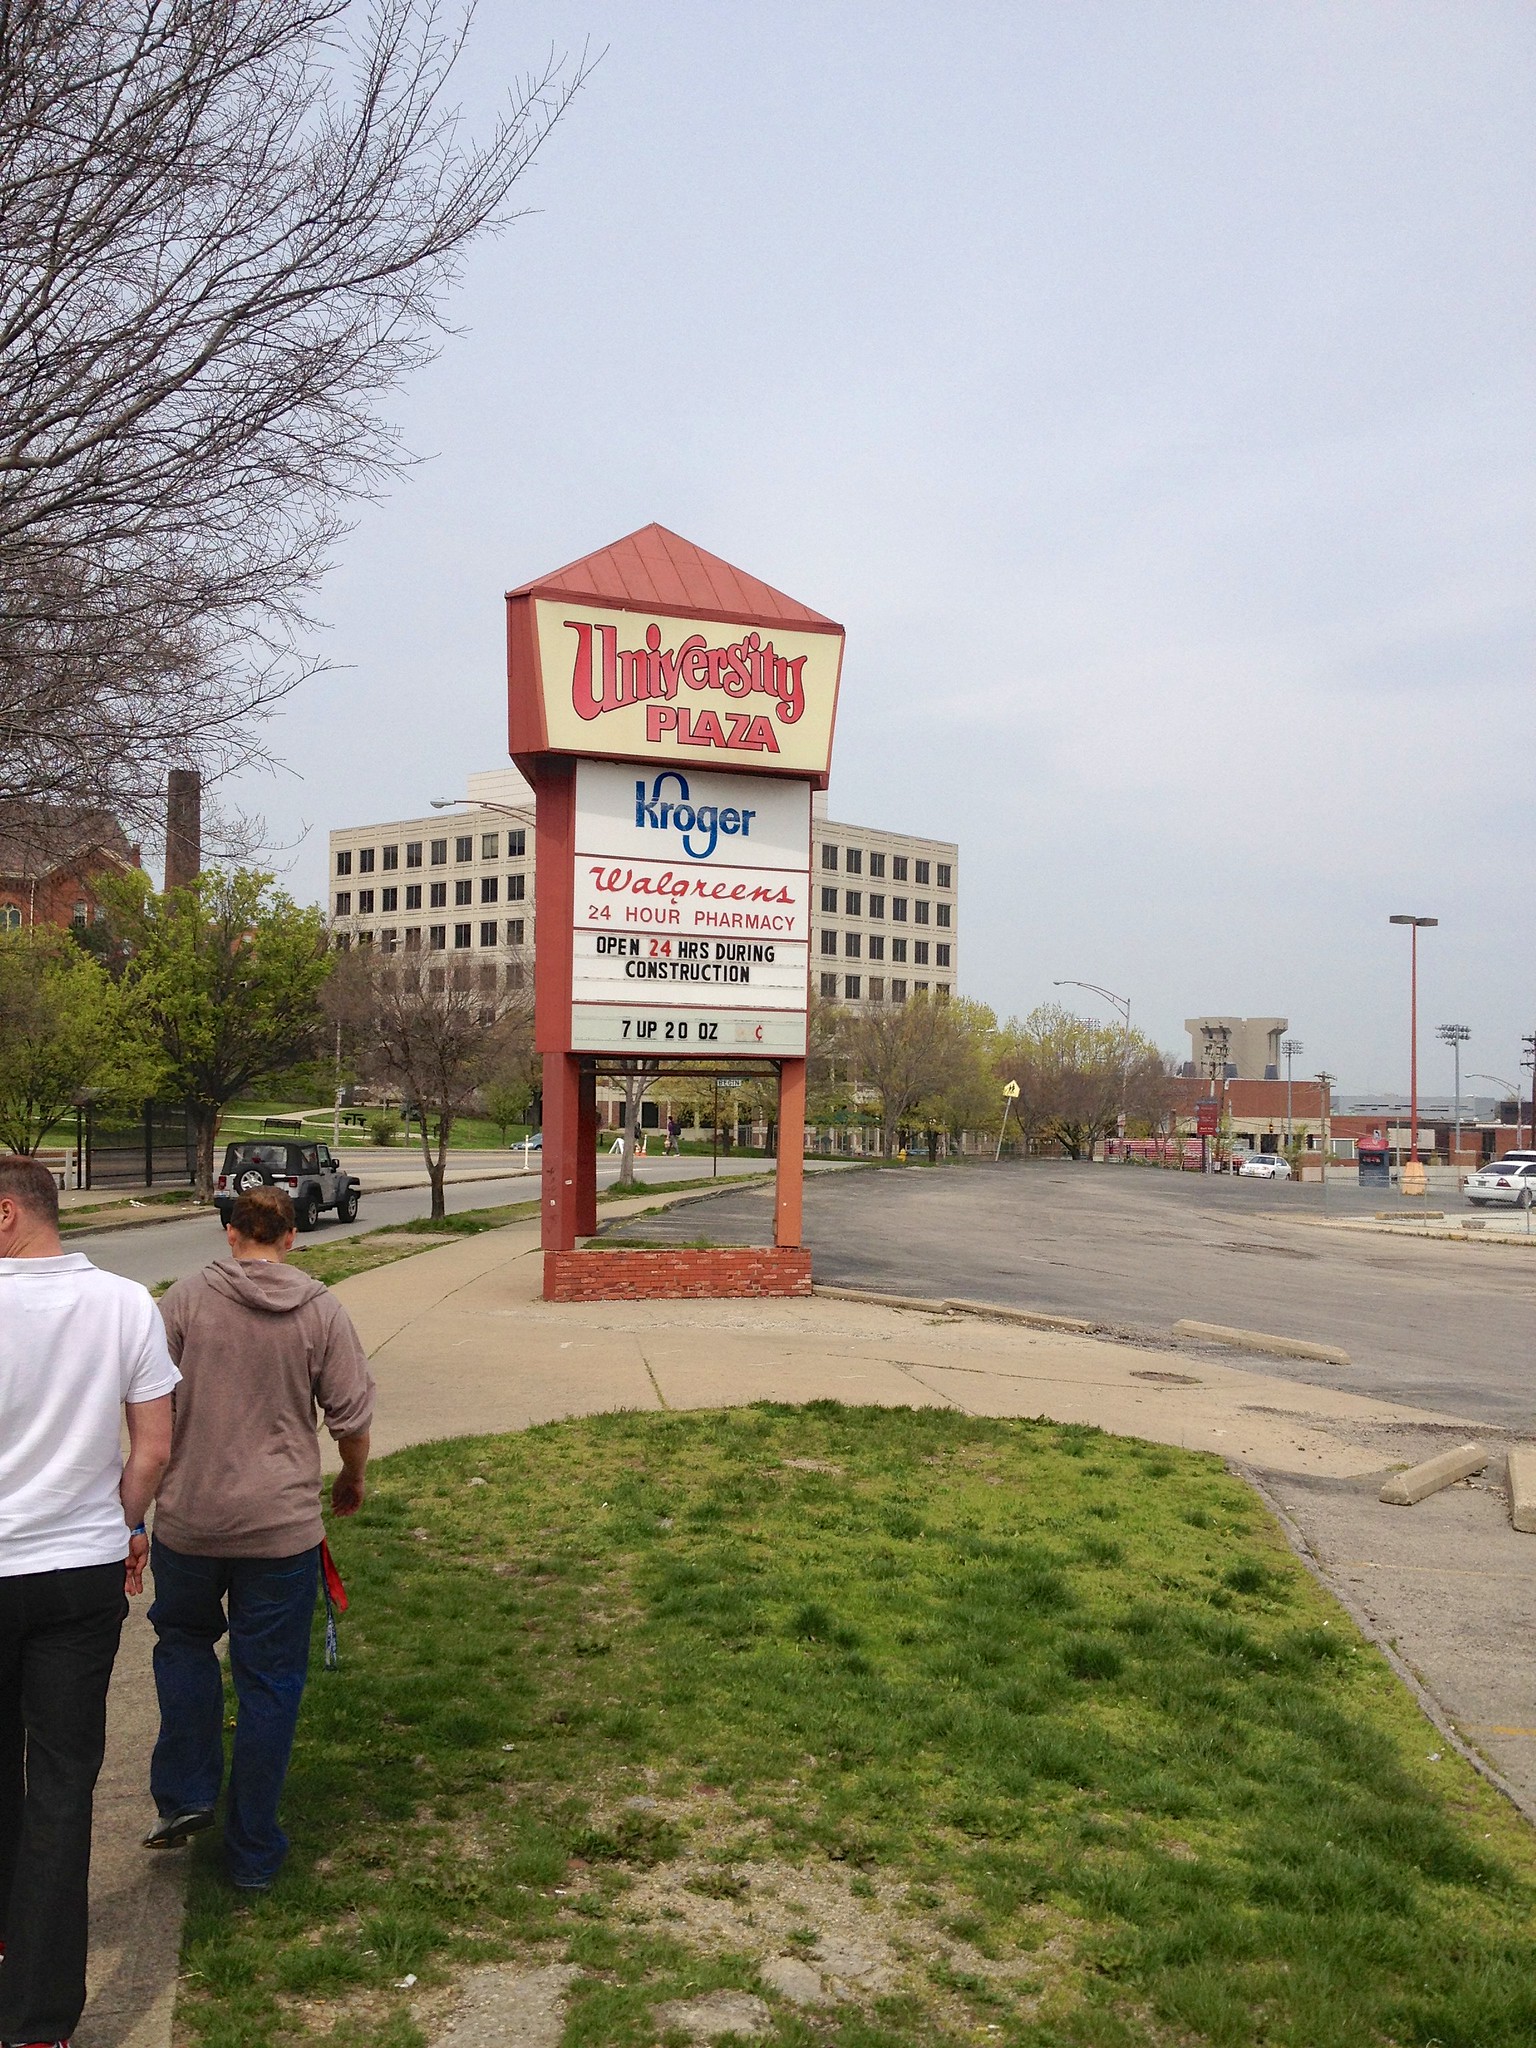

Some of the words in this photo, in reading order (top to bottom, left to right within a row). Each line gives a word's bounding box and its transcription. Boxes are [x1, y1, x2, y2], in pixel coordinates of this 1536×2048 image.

[563, 621, 808, 724] University
[646, 704, 781, 753] PLAZA
[635, 771, 756, 859] Kroger
[589, 867, 796, 905] Walgreens
[588, 904, 611, 921] 24
[625, 906, 681, 924] HOUR
[694, 910, 796, 931] PHARMACY
[596, 936, 640, 956] OPEN
[649, 939, 672, 957] 24
[678, 941, 709, 960] HRS
[715, 943, 775, 963] DURING
[625, 960, 750, 983] CONSTRUCTION
[622, 1020, 631, 1038] 7
[636, 1020, 658, 1038] UP
[698, 1022, 718, 1040] OZ
